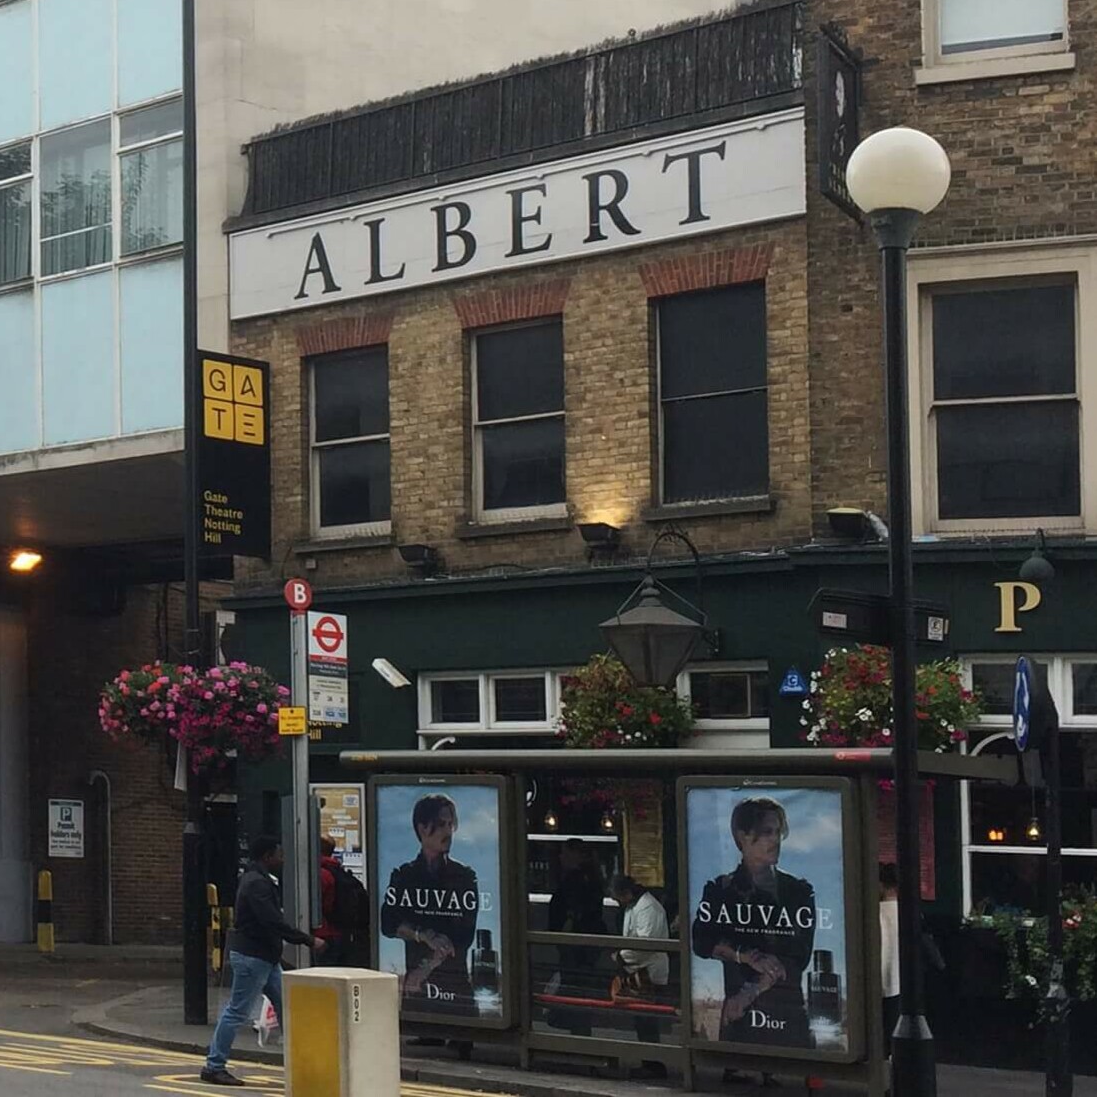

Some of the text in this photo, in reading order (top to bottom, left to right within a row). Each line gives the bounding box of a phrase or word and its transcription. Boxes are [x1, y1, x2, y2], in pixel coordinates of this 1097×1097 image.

[294, 140, 726, 300] ALBERT
[204, 490, 228, 504] Gate
[205, 503, 243, 520] Theatre
[205, 518, 242, 534] Notting
[205, 532, 222, 544] Hill
[293, 583, 307, 604] B
[993, 581, 1042, 632] P
[386, 886, 493, 912] SAUVAGE
[699, 901, 834, 930] SAUVAGE
[425, 983, 456, 1001] Dior
[750, 1009, 787, 1030] Dior
